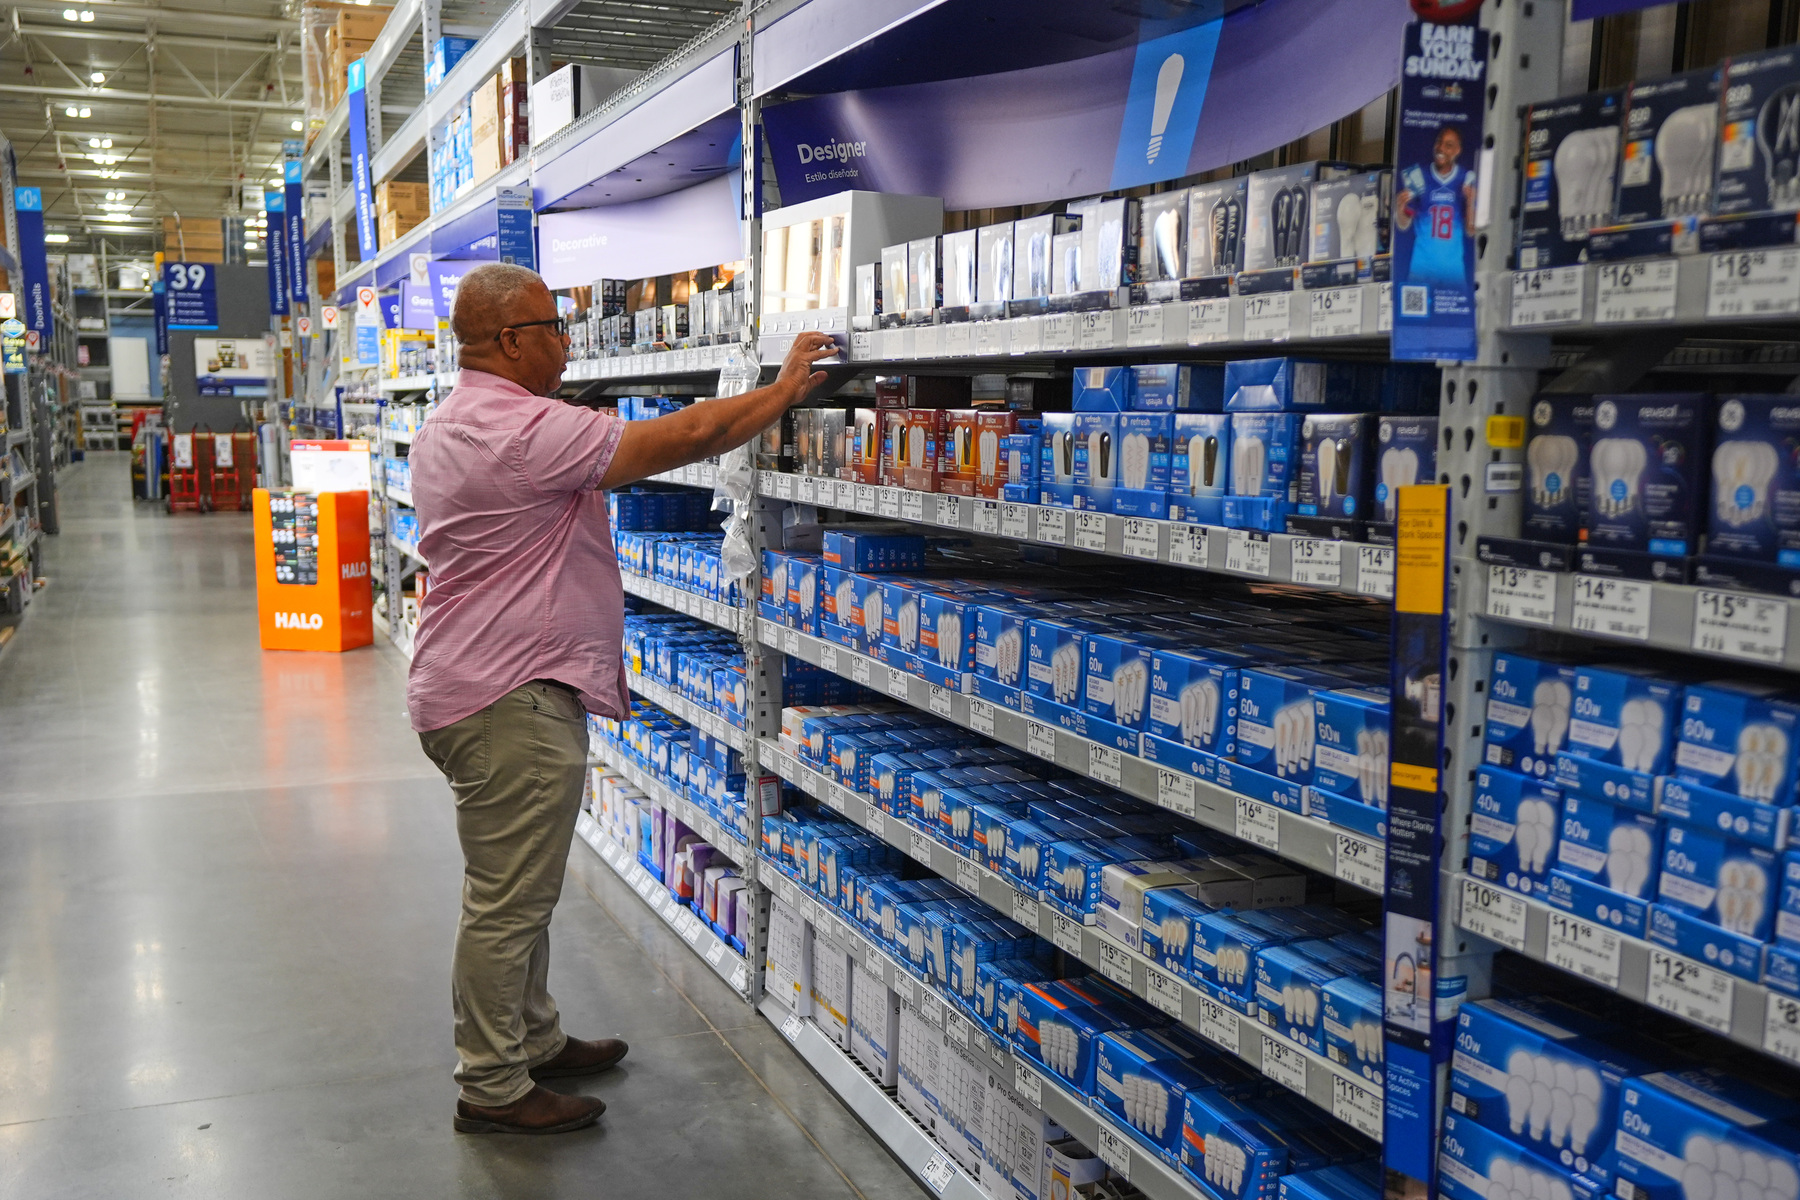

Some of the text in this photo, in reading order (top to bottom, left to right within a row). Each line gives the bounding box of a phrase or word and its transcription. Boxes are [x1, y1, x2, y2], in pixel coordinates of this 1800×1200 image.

[1420, 23, 1474, 44] EARN
[1421, 40, 1473, 60] YOUR
[1405, 56, 1484, 81] SUNDAY
[797, 138, 866, 164] Designer
[356, 153, 366, 190] Bulbs
[805, 168, 858, 184] Estilo diseñador
[358, 192, 372, 251] Specialty
[1430, 206, 1454, 240] 18
[273, 230, 281, 258] Lighting
[552, 234, 608, 252] Decorative
[170, 264, 206, 290] 39
[292, 243, 303, 296] Fluorescent
[274, 258, 284, 310] Fluorescent
[35, 283, 46, 330] Doorbells
[1085, 416, 1101, 424] refresh
[1639, 404, 1678, 419] reveal
[1131, 418, 1151, 426] refresh
[1317, 422, 1336, 431] reveal
[1397, 425, 1419, 435] reveal
[1417, 529, 1443, 540] Spaces
[342, 561, 367, 579] HALO
[274, 612, 323, 630] HALO
[977, 625, 988, 639] 60w
[1030, 646, 1042, 659] 60w
[1089, 657, 1103, 673] 60w
[1153, 674, 1167, 692] 60w
[1494, 679, 1517, 698] 40w
[1241, 698, 1259, 717] 60w
[1575, 697, 1601, 717] 60w
[1318, 723, 1340, 743] 60w
[1684, 718, 1715, 742] 60w
[1476, 793, 1501, 813] 40w
[1564, 818, 1590, 841] 60w
[1666, 850, 1696, 873] 60w
[784, 909, 794, 924] Series
[824, 938, 836, 953] Series
[917, 1008, 929, 1028] Series
[1324, 1005, 1339, 1018] 40w
[1457, 1032, 1481, 1054] 40w
[950, 1042, 958, 1056] Pro
[959, 1047, 974, 1068] Series
[1098, 1052, 1112, 1072] 100w
[997, 1082, 1006, 1098] Pro
[1007, 1089, 1024, 1111] Series
[1622, 1110, 1651, 1136] 60w
[1443, 1134, 1464, 1158] 40w
